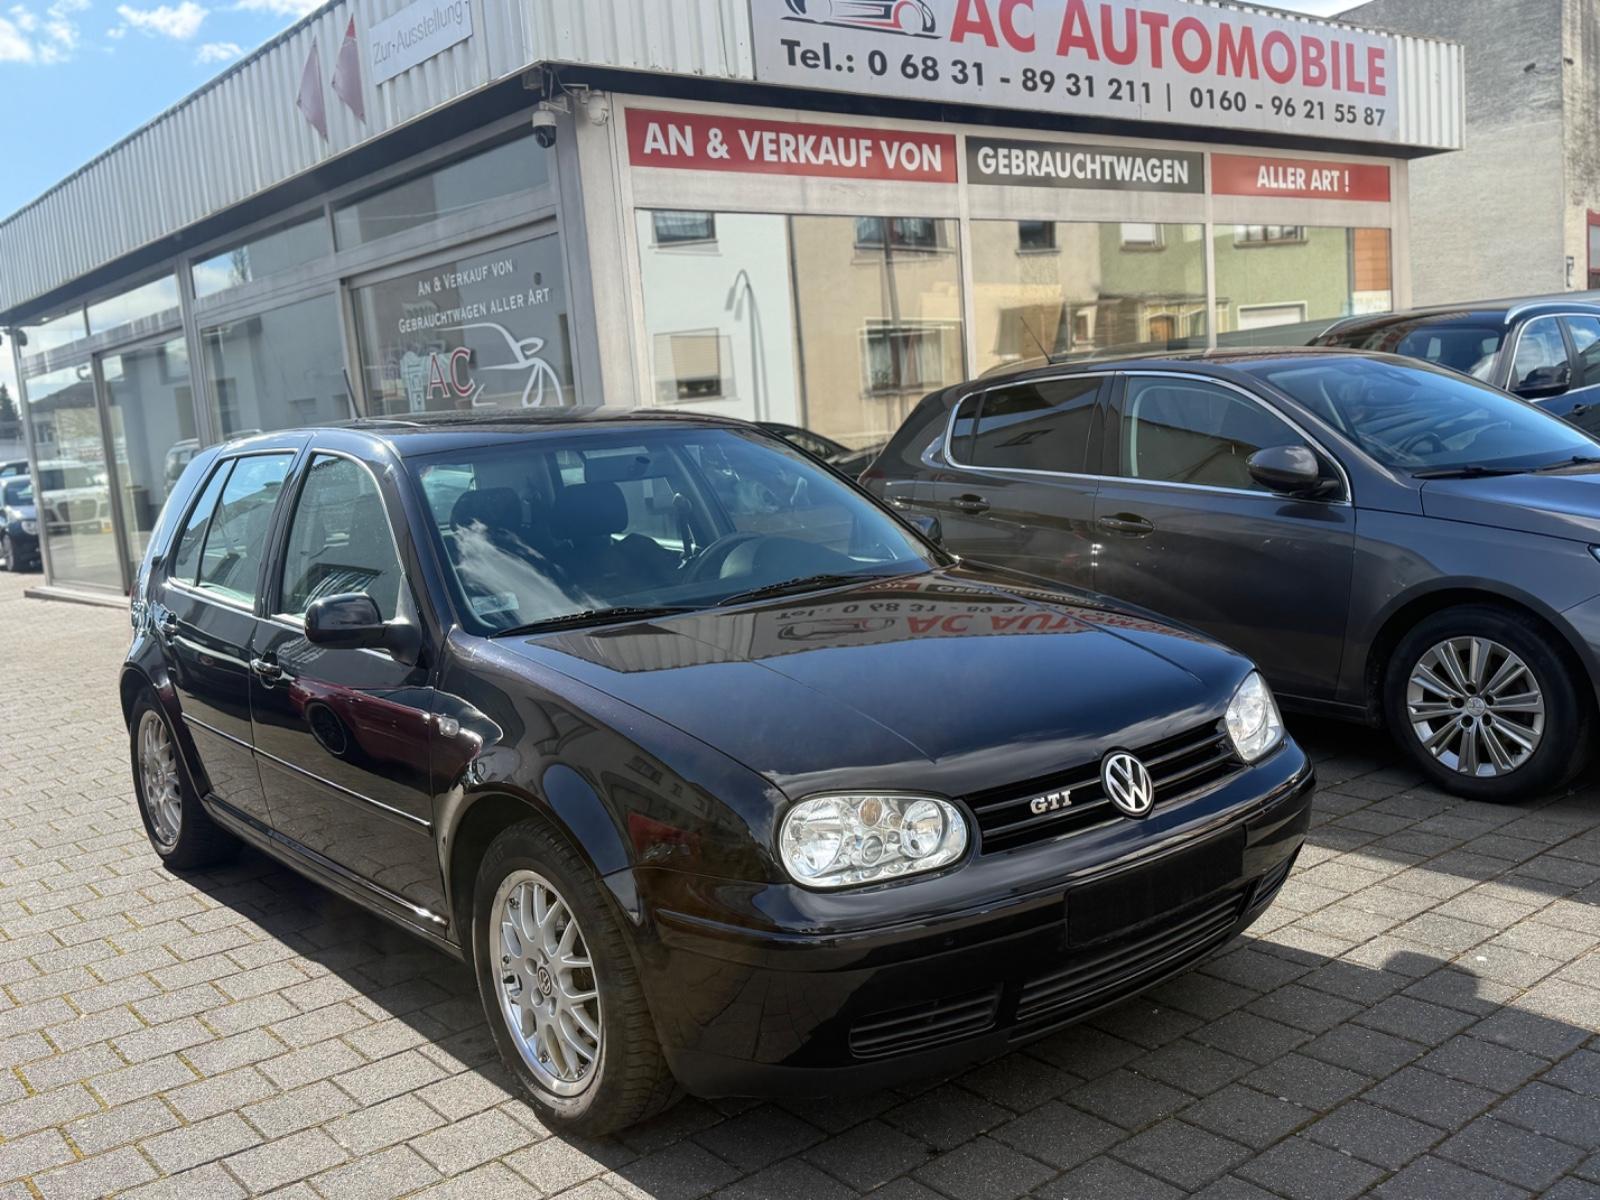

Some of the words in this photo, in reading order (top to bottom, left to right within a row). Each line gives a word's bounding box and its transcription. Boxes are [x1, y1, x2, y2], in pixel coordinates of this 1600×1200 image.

[372, 40, 392, 65] Zur
[396, 0, 464, 54] Ausstellung
[950, 0, 1036, 53] AC
[1056, 0, 1387, 96] AUTOMOBILE
[780, 38, 855, 74] Tel.:
[868, 49, 888, 76] 0
[900, 54, 940, 81] 68
[951, 59, 984, 86] 31
[999, 75, 1011, 84] -
[1021, 67, 1056, 93] 89
[1065, 72, 1095, 97] 31
[1107, 77, 1151, 104] 211
[1190, 87, 1247, 112] 0160
[1271, 95, 1296, 118] 96
[1303, 100, 1325, 121] 21
[1334, 103, 1358, 124] 55
[1364, 107, 1386, 127] 87
[643, 122, 695, 157] AN
[706, 127, 731, 159] &
[738, 129, 873, 168] VERKAUF
[879, 140, 943, 172] VON
[976, 146, 1189, 185] GEBRAUCHTWAGEN
[1256, 165, 1307, 190] ALLER
[1310, 168, 1340, 192] ART
[1343, 170, 1350, 193] !
[433, 276, 442, 293] &
[426, 346, 476, 400] AC
[1030, 789, 1071, 815] GTI
